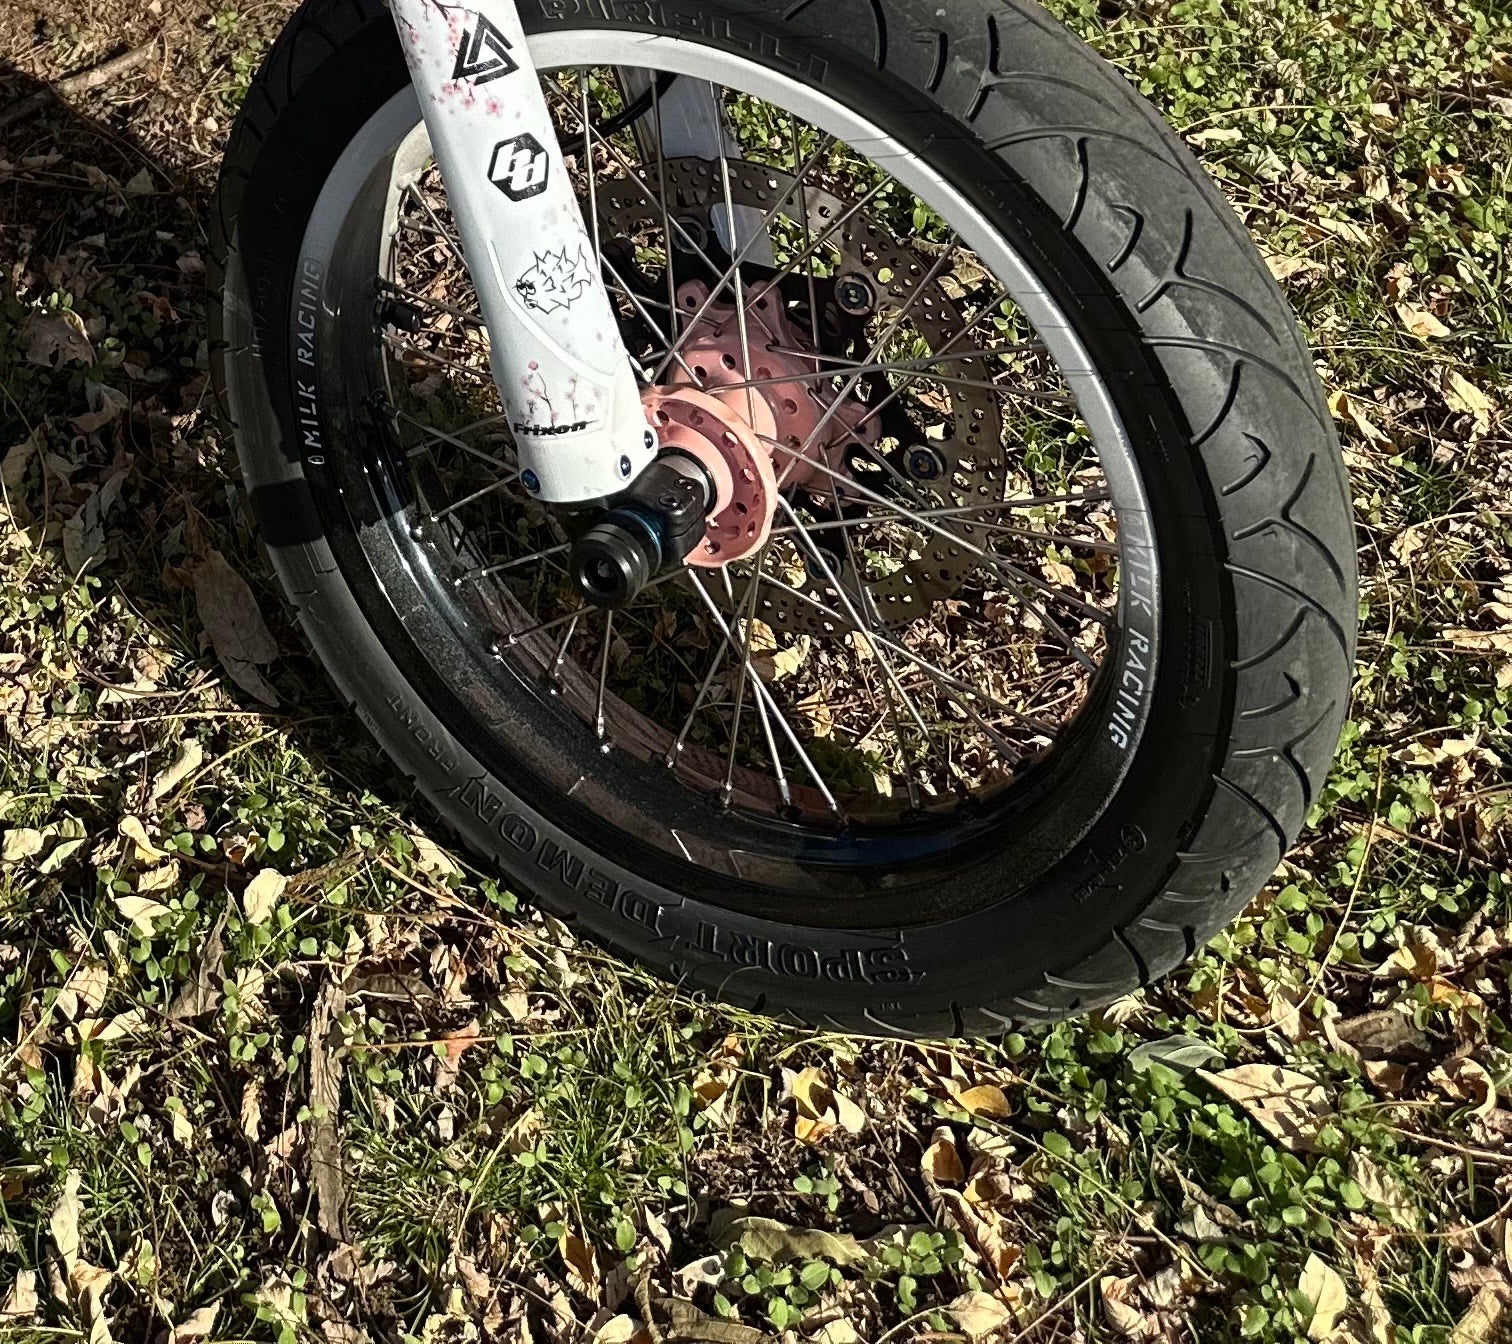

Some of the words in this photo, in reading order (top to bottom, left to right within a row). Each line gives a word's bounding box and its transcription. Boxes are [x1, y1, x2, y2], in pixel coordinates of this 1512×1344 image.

[297, 258, 322, 367] RACING
[297, 380, 323, 449] MILK
[513, 418, 588, 436] Frixon
[1125, 532, 1152, 618] MILK
[1108, 626, 1150, 750] RACING
[458, 772, 666, 937] DEMON
[690, 920, 918, 985] SPORT
